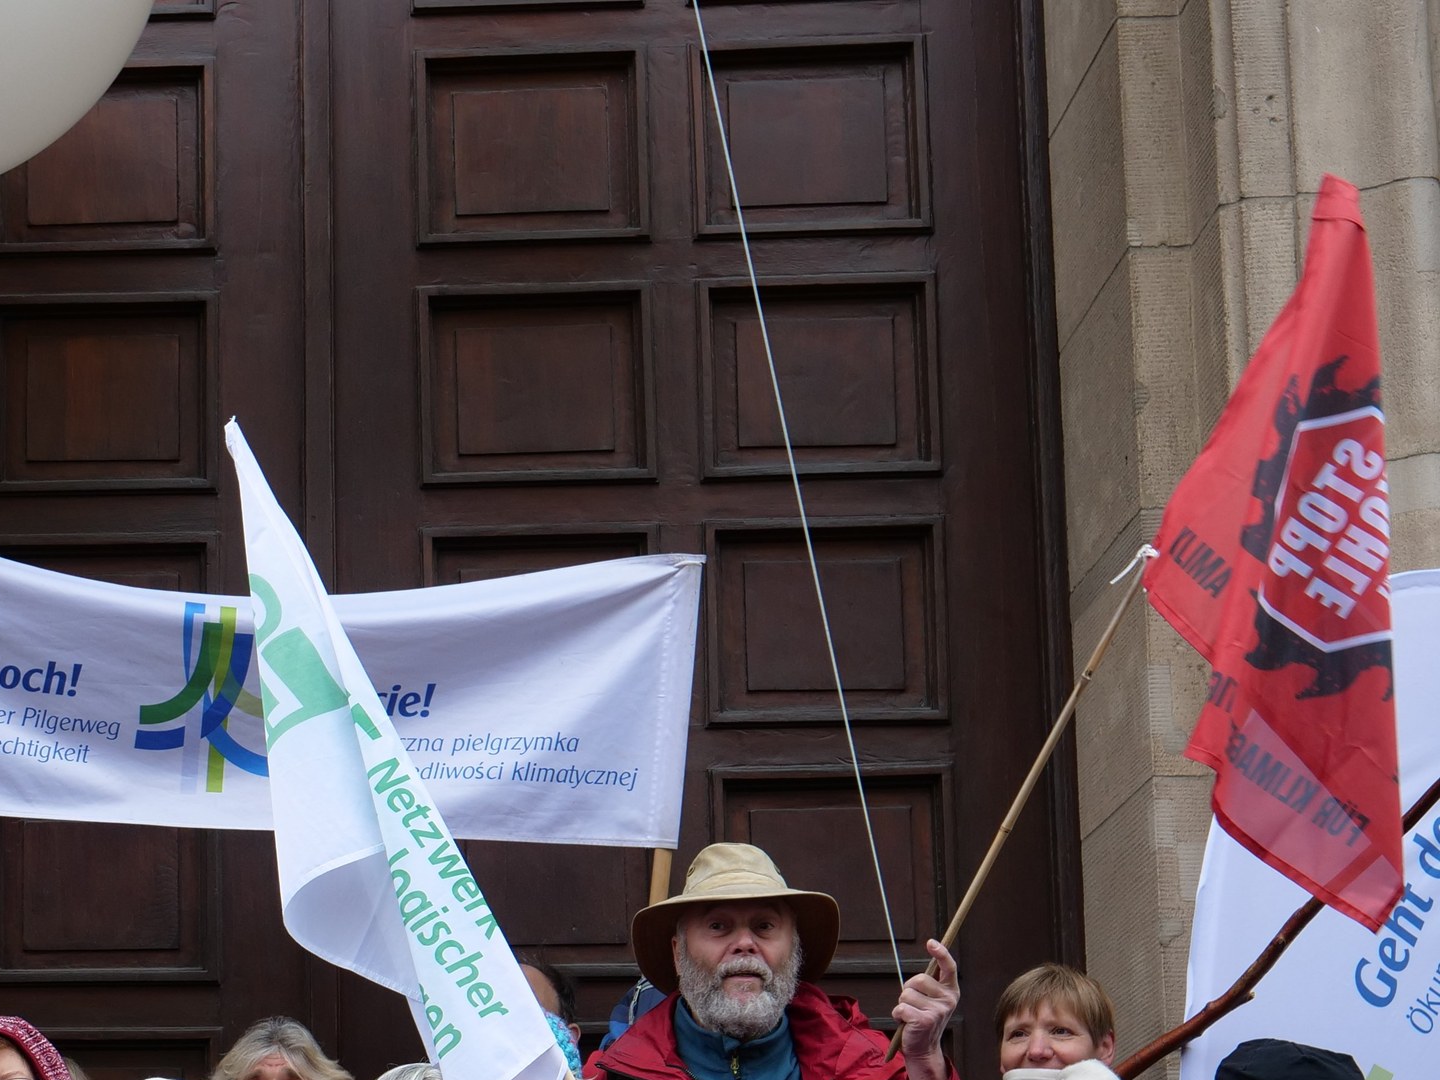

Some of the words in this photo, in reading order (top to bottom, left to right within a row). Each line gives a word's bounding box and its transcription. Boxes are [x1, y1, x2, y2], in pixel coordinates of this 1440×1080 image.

[20, 706, 122, 741] Pilgerweg
[452, 733, 580, 757] pielgrzymka
[511, 762, 639, 793] klimatycznej
[1354, 883, 1434, 1009] Geht
